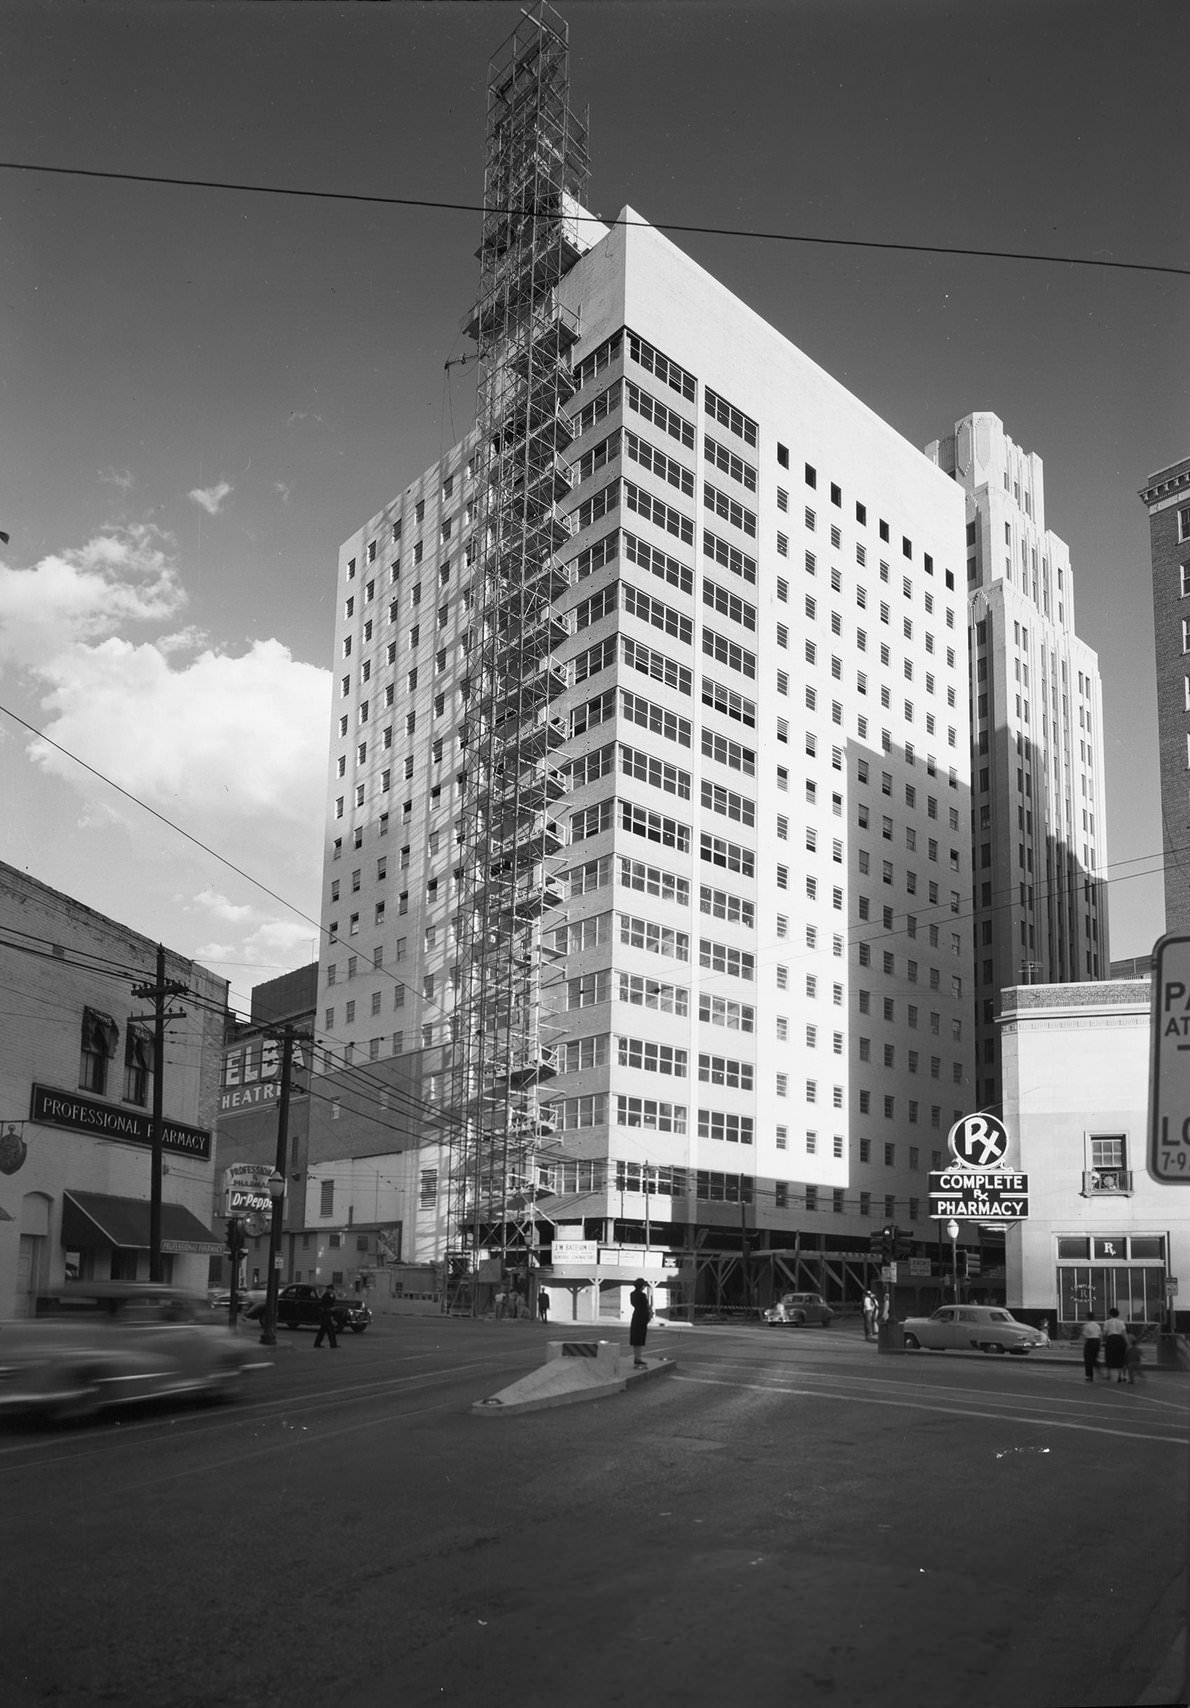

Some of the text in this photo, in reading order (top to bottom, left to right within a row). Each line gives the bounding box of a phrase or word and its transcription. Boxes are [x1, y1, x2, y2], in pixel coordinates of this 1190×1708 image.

[1165, 982, 1190, 1013] P
[225, 1040, 305, 1088] ELBA
[219, 1081, 282, 1109] HEATR
[43, 1097, 206, 1151] PROFESSIONAL PARMACY
[940, 1175, 1023, 1189] COMPLETE
[232, 1192, 273, 1211] Dr Peppe
[937, 1201, 1024, 1215] PHARMACY
